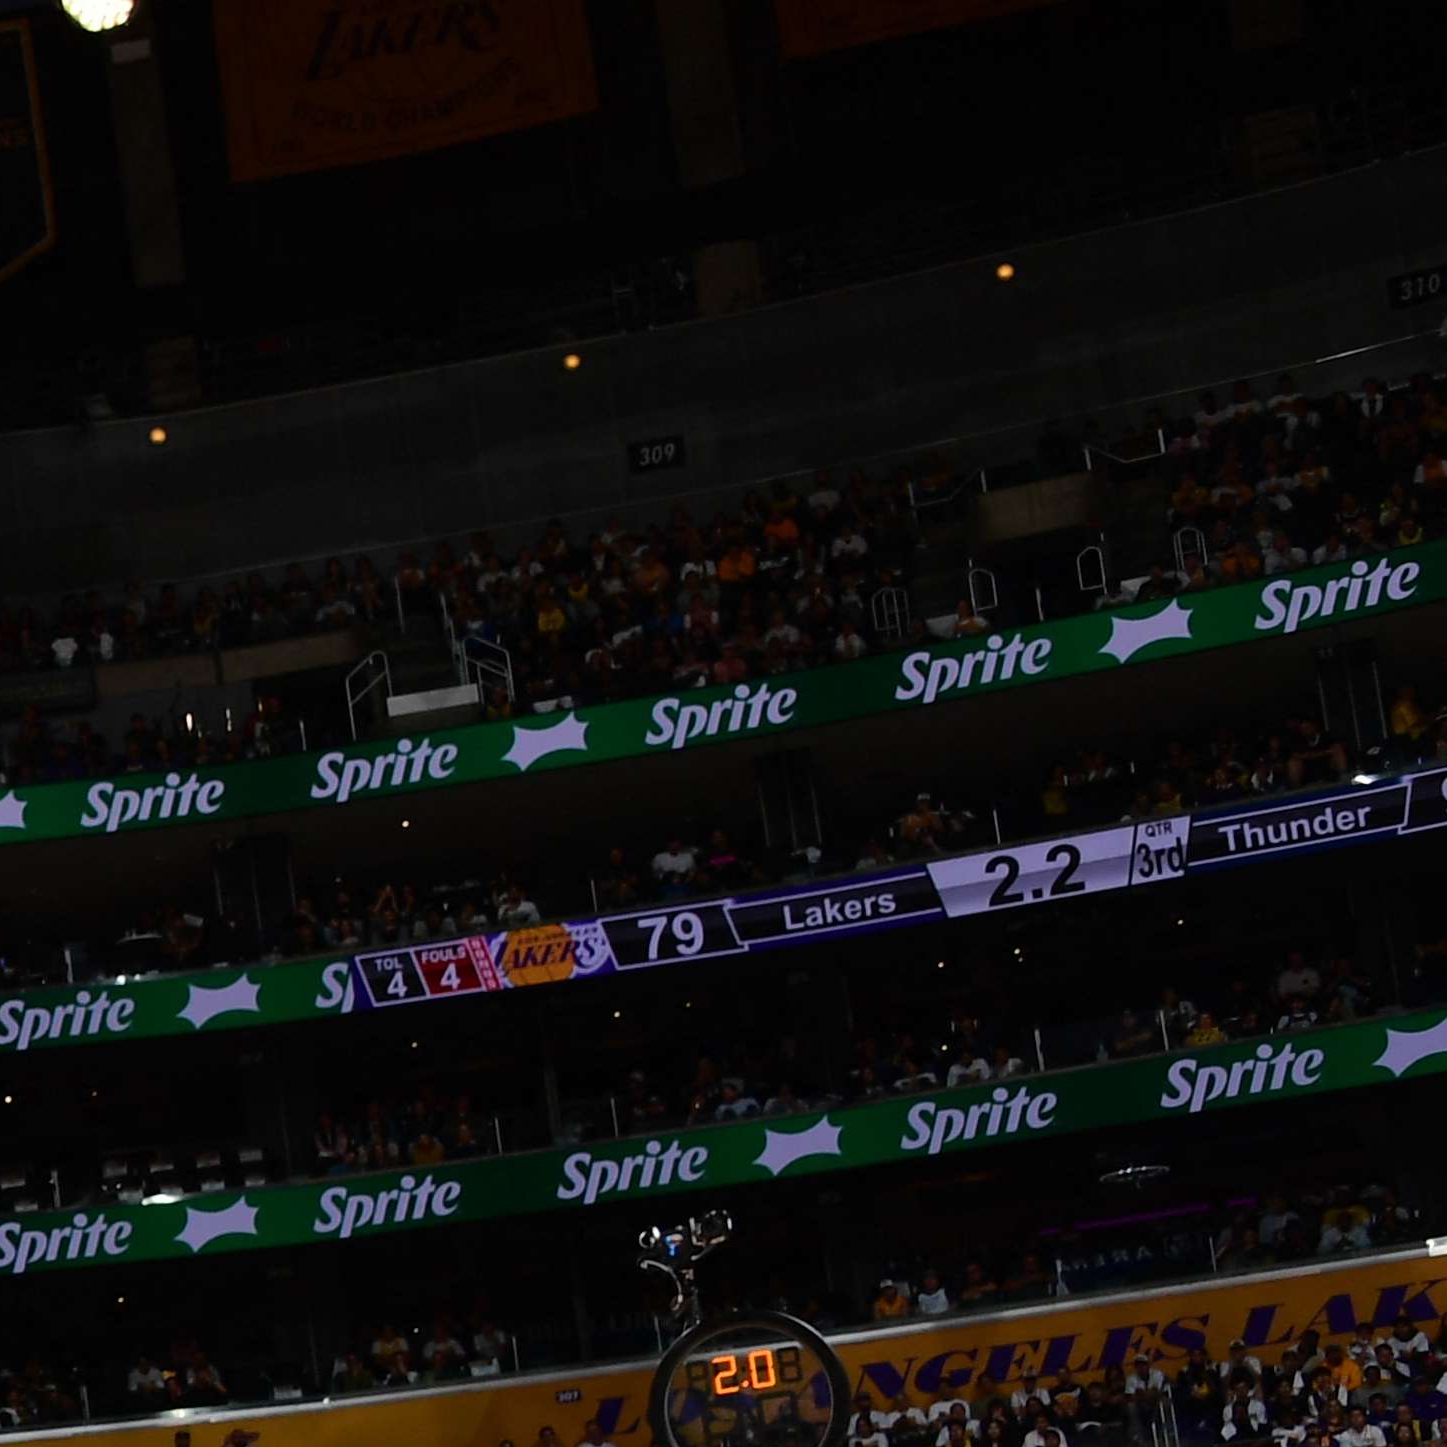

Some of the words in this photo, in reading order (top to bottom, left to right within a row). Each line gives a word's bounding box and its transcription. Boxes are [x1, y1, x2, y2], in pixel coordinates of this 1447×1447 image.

[304, 2, 502, 81] LAKERS
[1402, 273, 1440, 301] 310
[639, 442, 676, 467] 309
[1255, 559, 1419, 632] Sprite
[896, 634, 1051, 703] Sprite
[646, 685, 796, 748] Sprite
[312, 739, 457, 802] Sprite
[82, 773, 224, 831] Sprite
[1144, 821, 1173, 838] QTR
[1217, 802, 1373, 854] Thunder
[985, 844, 1086, 908] 2.2
[1137, 838, 1187, 879] 3rd
[636, 911, 706, 961] 79
[782, 890, 897, 932] Lakers
[373, 954, 404, 971] TOL
[420, 944, 467, 964] FOULS
[440, 964, 462, 990] 4
[495, 930, 606, 972] LAKERS
[386, 972, 408, 998] 4
[1161, 1045, 1323, 1112] Sprite
[904, 1088, 1056, 1154] Sprite
[558, 1141, 707, 1204] Sprite
[315, 1176, 461, 1238] Sprite
[1242, 1277, 1447, 1348] LAK
[711, 1348, 777, 1397] 2.0
